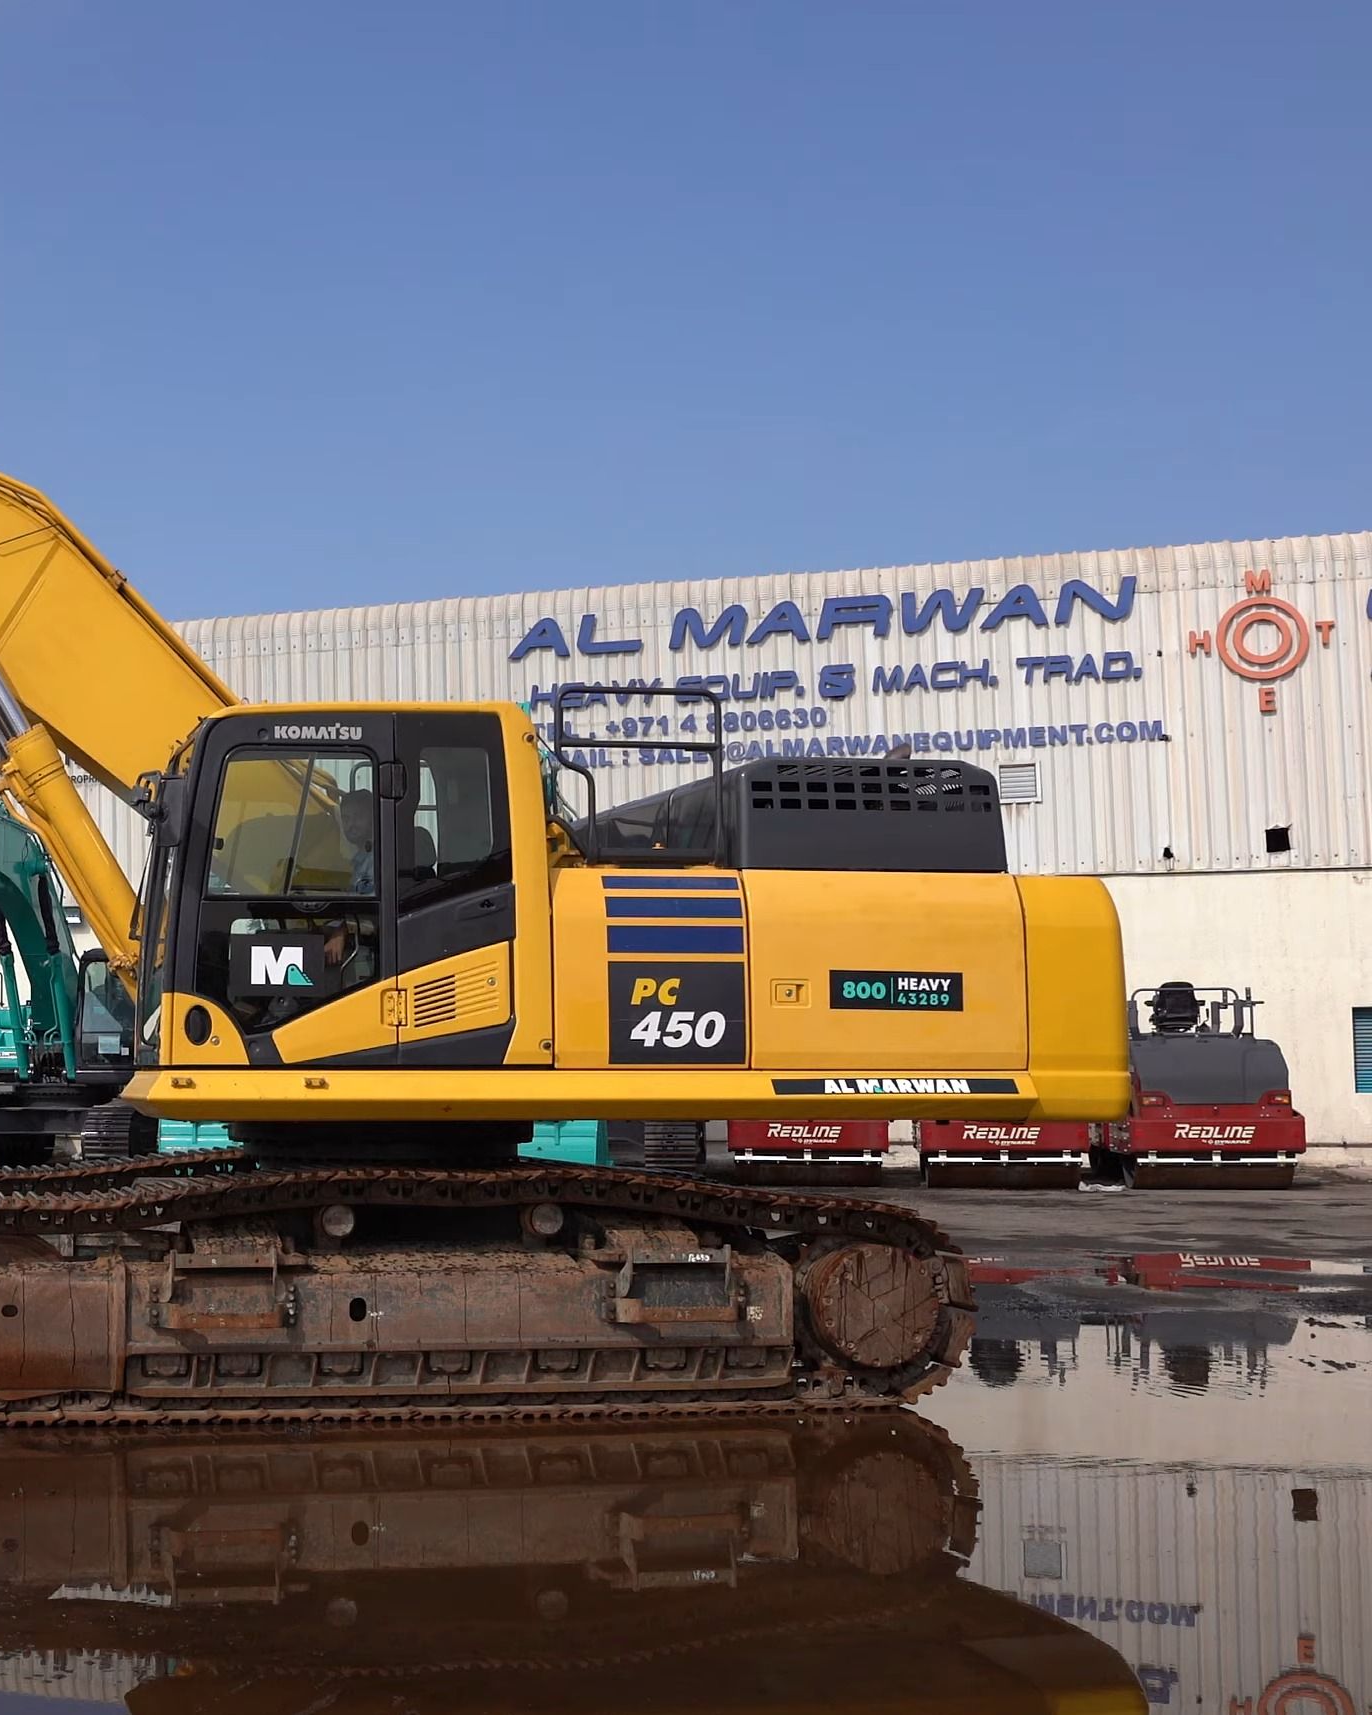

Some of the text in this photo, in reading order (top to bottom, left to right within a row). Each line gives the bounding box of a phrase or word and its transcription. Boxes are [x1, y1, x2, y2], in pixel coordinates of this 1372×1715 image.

[509, 576, 1137, 660] AL MARWAN
[531, 651, 1142, 711] HEAVY EQUIP. & MACH. TRAD.
[274, 723, 362, 740] KOMATSU
[605, 715, 669, 738] +971
[680, 714, 697, 733] 4
[630, 978, 681, 1006] PC
[842, 977, 951, 999] 800 HEAVY
[897, 993, 950, 1005] 43289
[630, 1011, 726, 1048] 450
[824, 1079, 971, 1093] AL MARWAN
